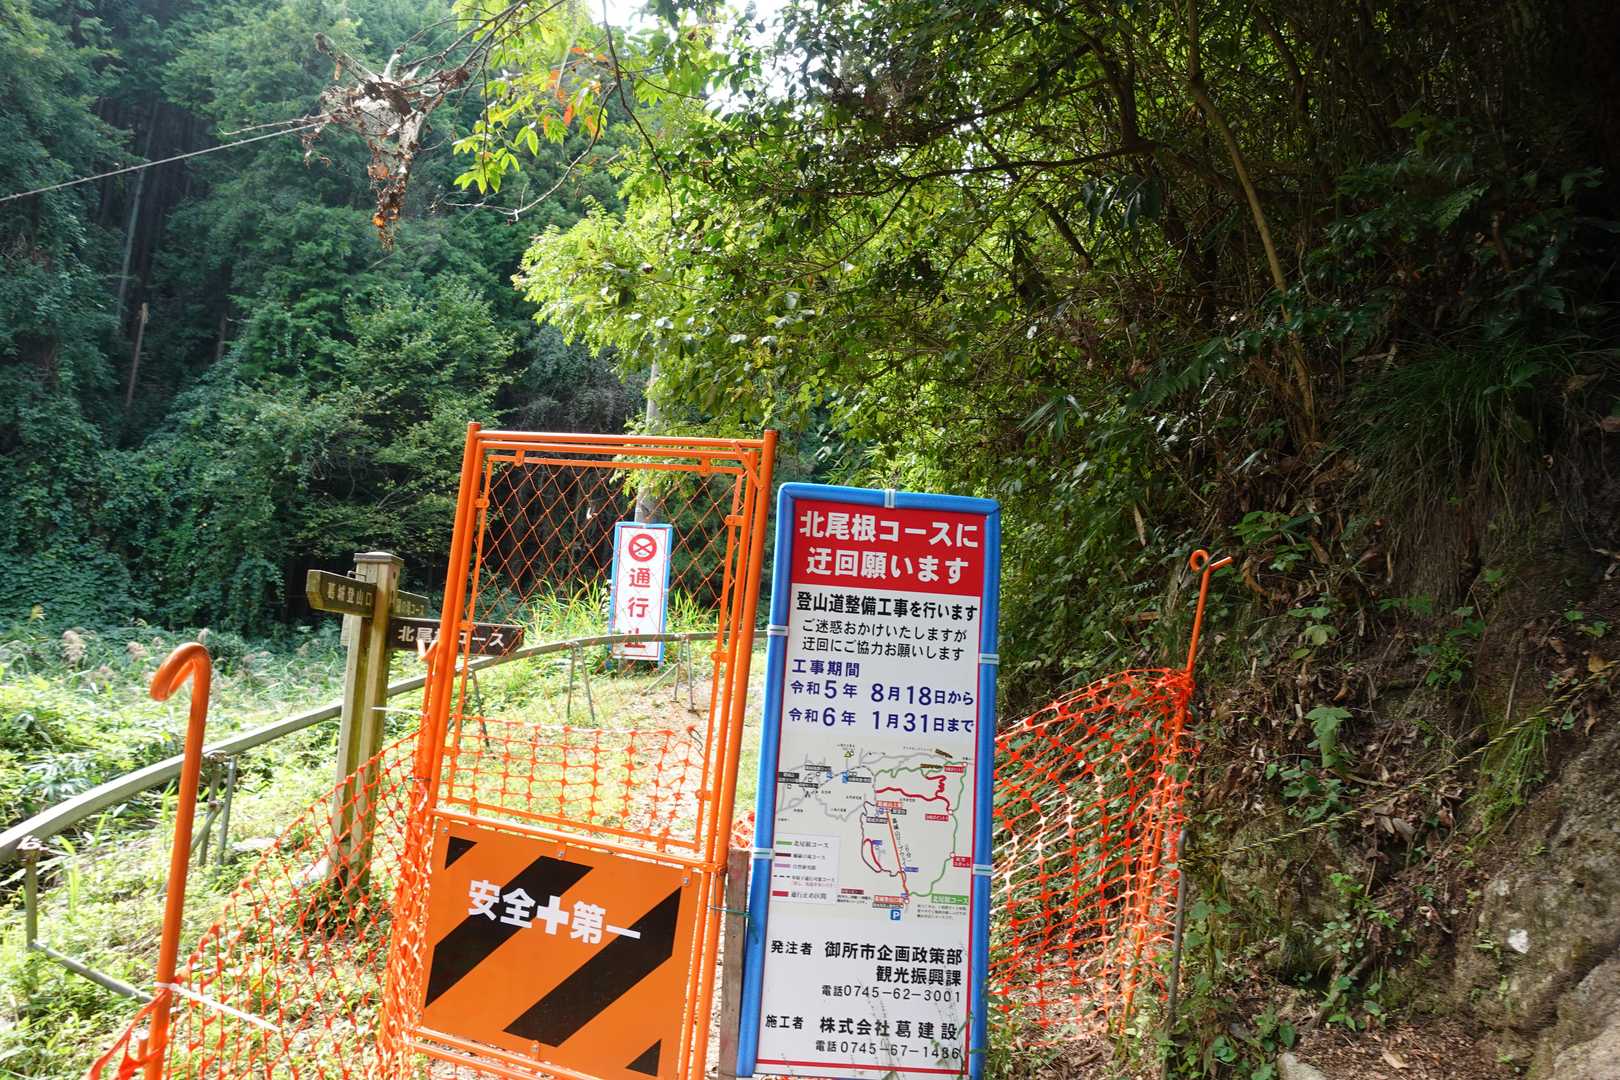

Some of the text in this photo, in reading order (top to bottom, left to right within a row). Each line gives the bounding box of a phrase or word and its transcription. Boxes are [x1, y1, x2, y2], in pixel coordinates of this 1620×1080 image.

[799, 510, 979, 548] 北尾根コースに
[806, 546, 969, 584] 迂回願います
[796, 591, 978, 622] 登山道整備工事を行います
[397, 625, 504, 647] 北尾コース
[802, 618, 967, 643] ご迷惑おかけいたしますが
[801, 636, 965, 662] 迂回にご協力お願いします
[791, 658, 860, 678] 工事期間
[790, 680, 975, 706] 令和5年 8月18日から
[788, 707, 975, 734] 令和6年 1月31日まで
[770, 940, 963, 966] 発注者 御所市企画政策部
[876, 965, 962, 987] 観光振興課
[765, 1015, 804, 1031] 施工者
